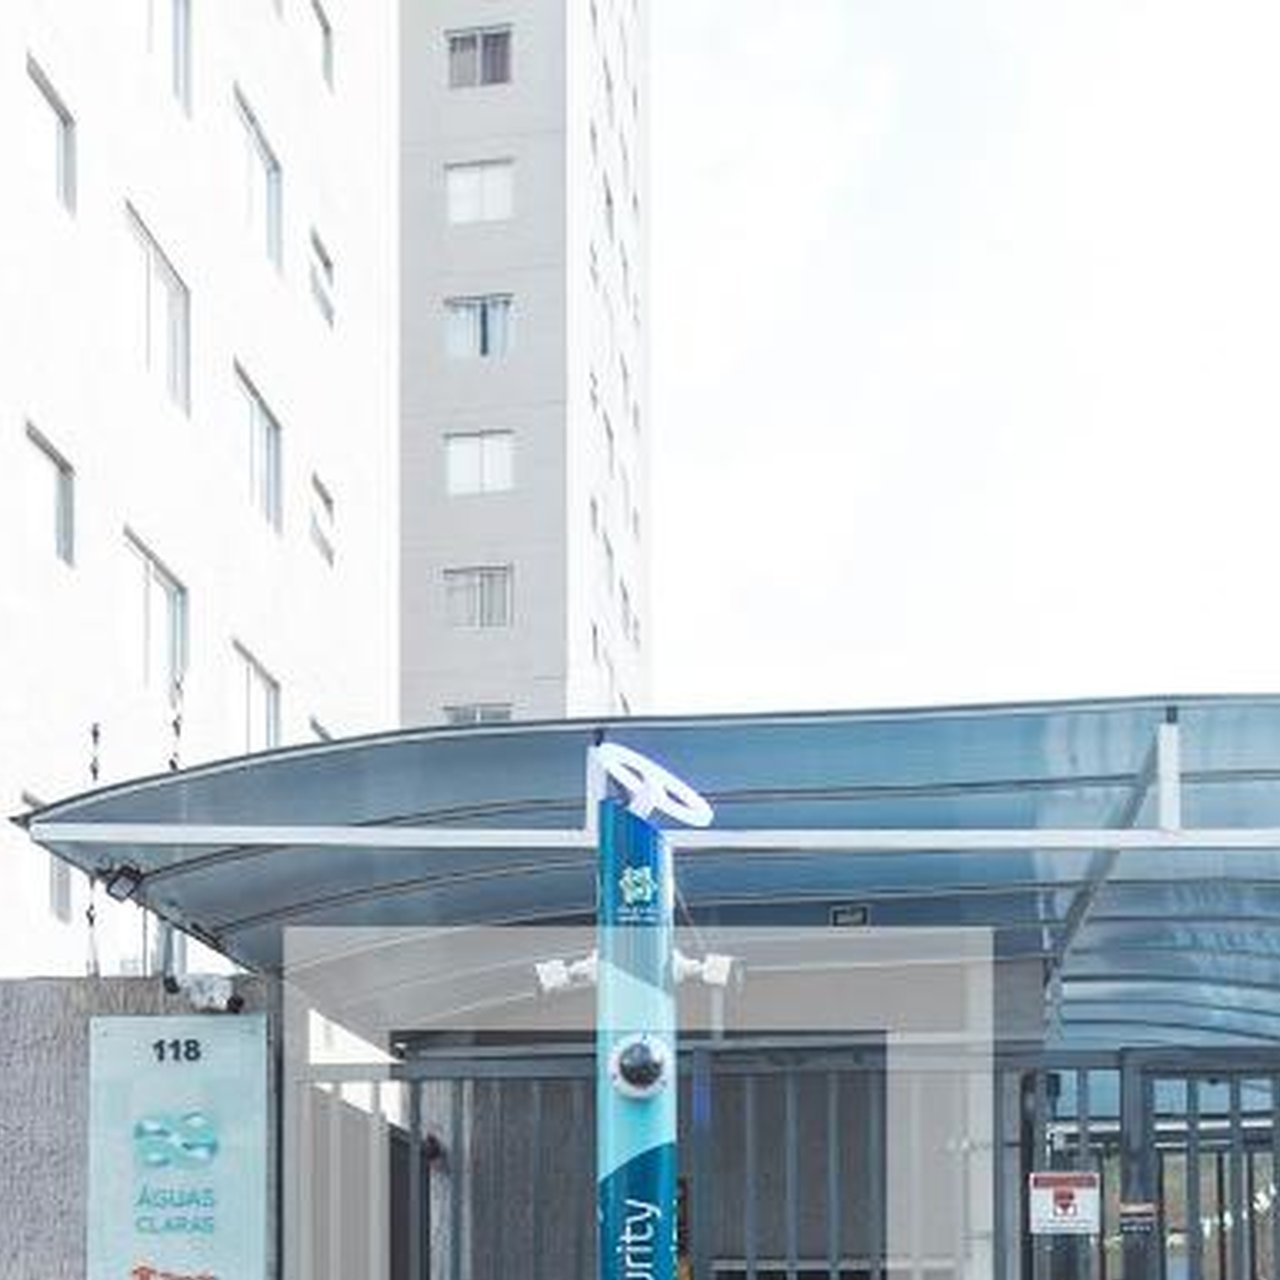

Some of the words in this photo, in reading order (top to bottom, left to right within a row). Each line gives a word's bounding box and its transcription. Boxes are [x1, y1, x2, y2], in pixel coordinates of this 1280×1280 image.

[152, 1038, 201, 1062] 118
[135, 1184, 215, 1209] ÁGUAS
[135, 1216, 215, 1235] CLARAS
